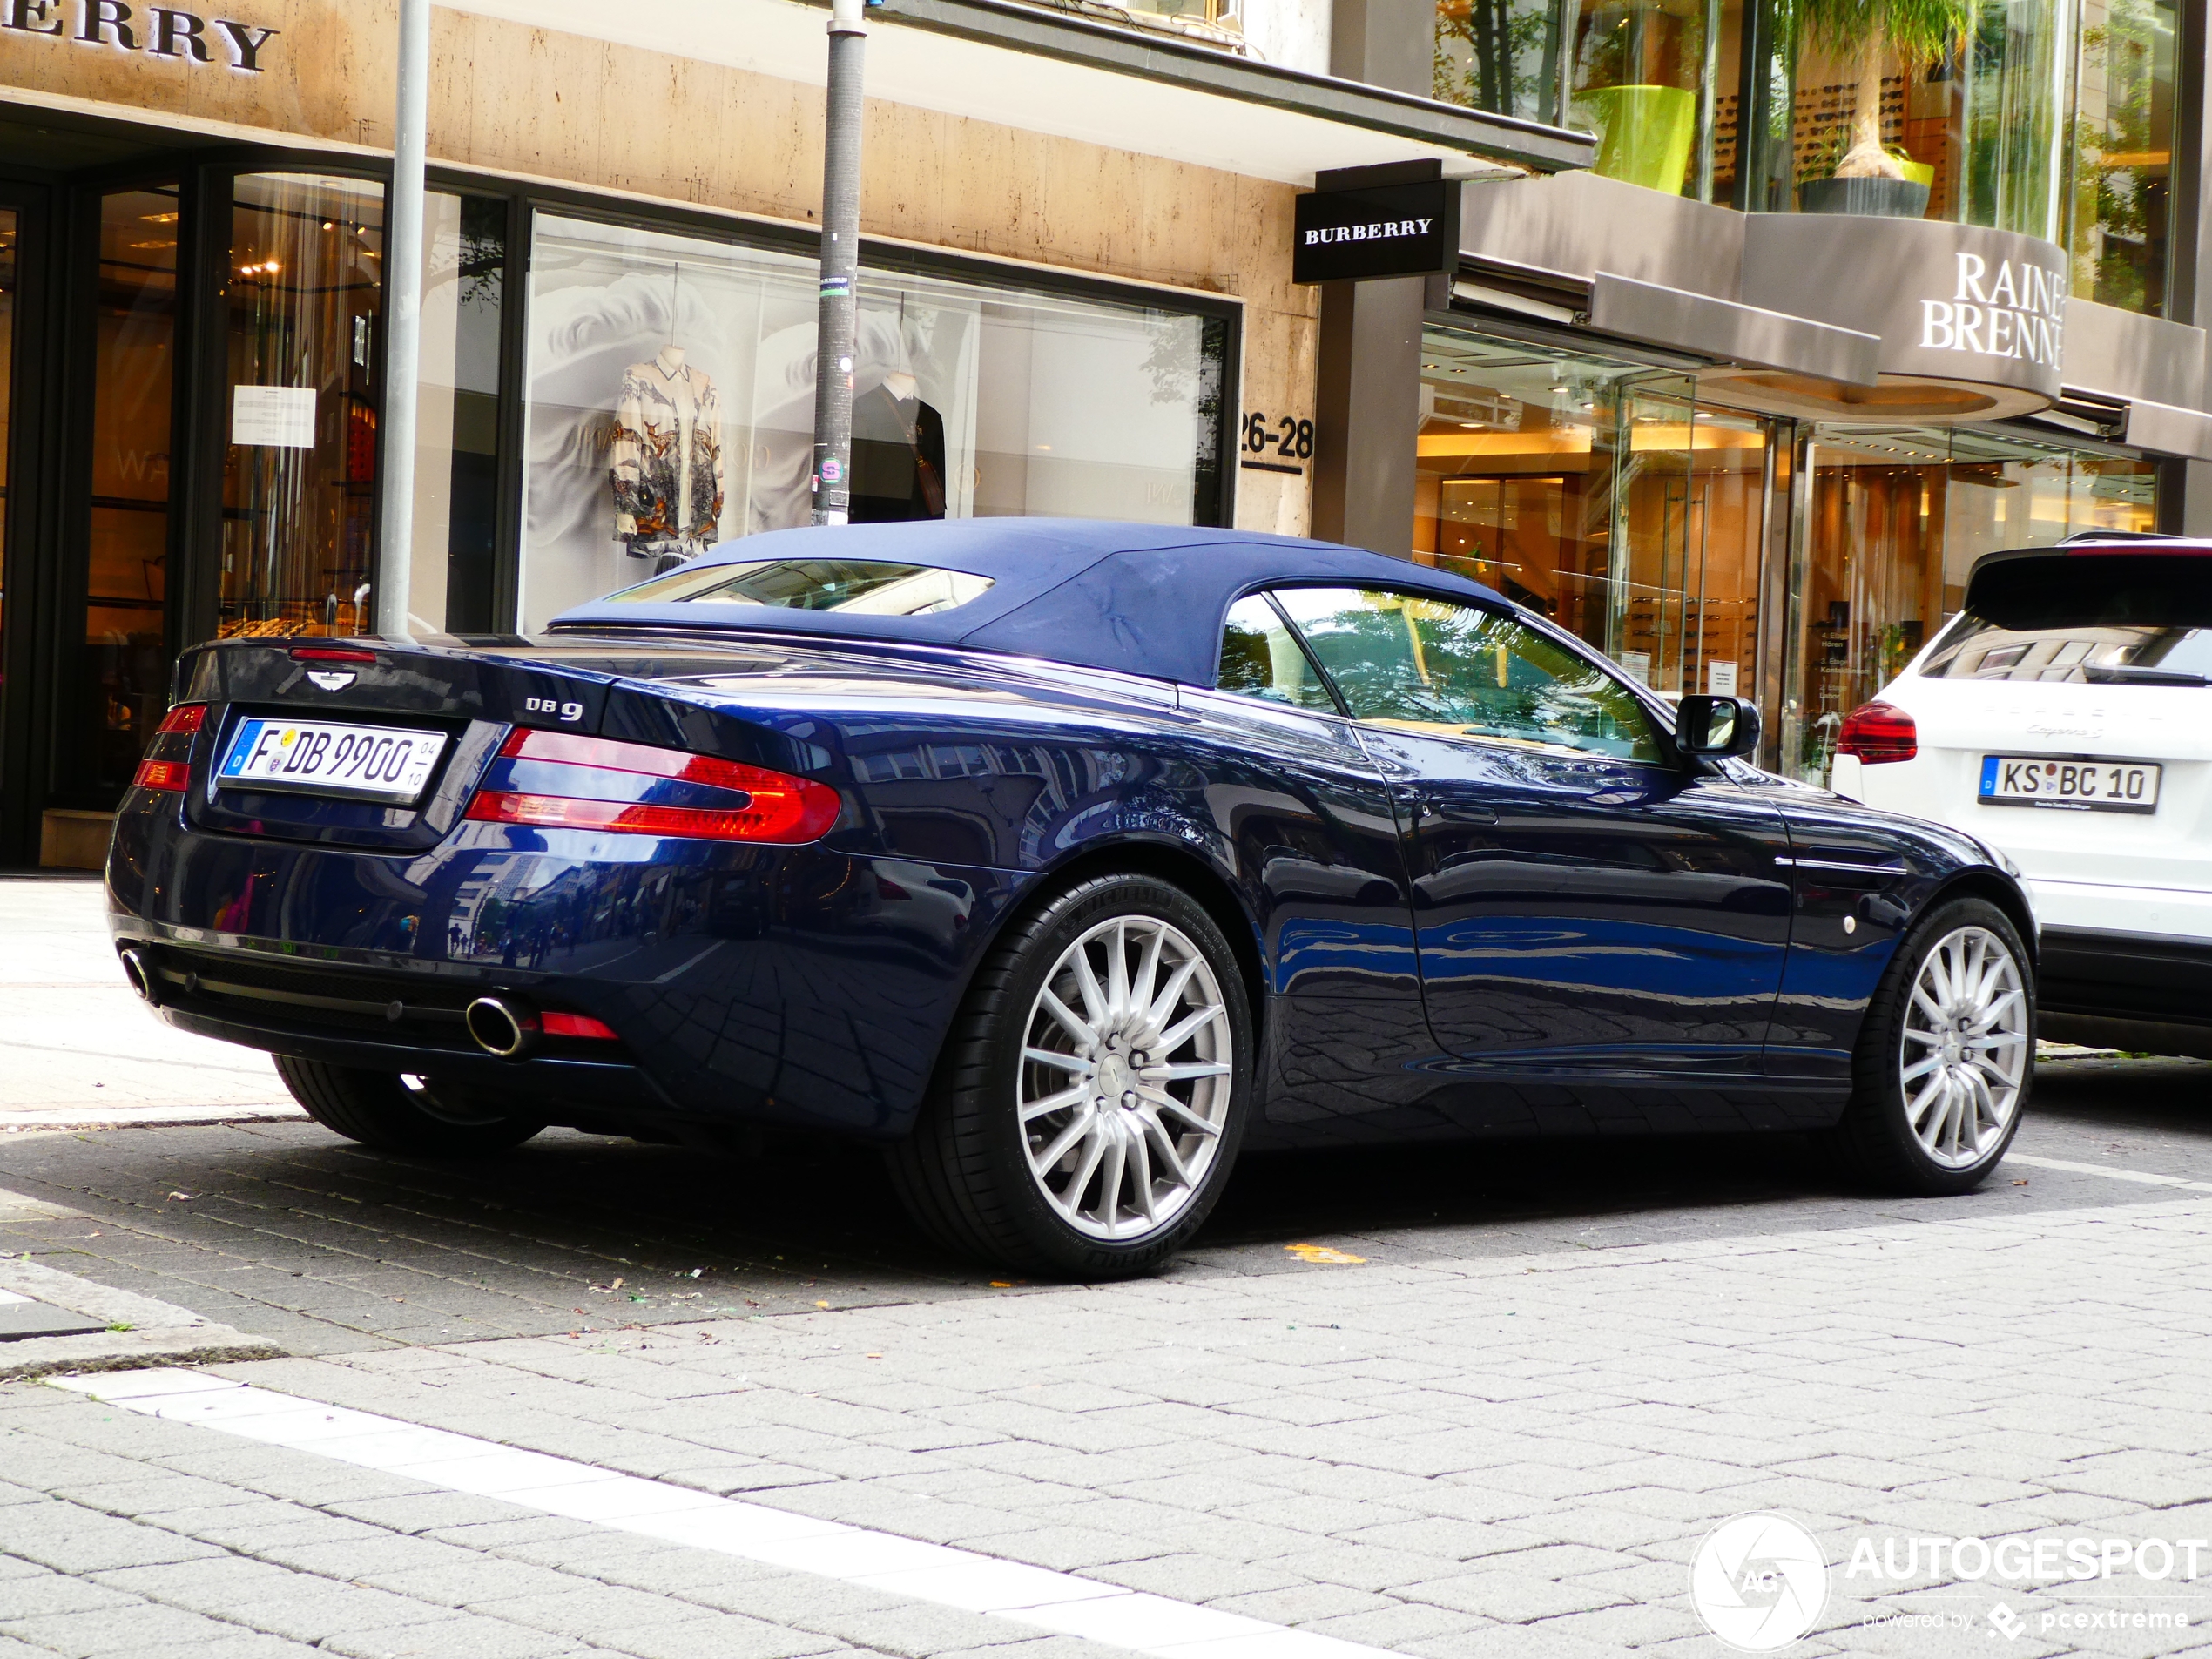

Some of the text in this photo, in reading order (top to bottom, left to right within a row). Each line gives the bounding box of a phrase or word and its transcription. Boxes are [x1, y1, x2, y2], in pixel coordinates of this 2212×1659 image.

[1305, 218, 1433, 245] BURBERRY
[1952, 252, 2066, 322] RAINE
[232, 755, 242, 767] D
[247, 729, 280, 771] F
[2003, 763, 2145, 799] KS BC 10
